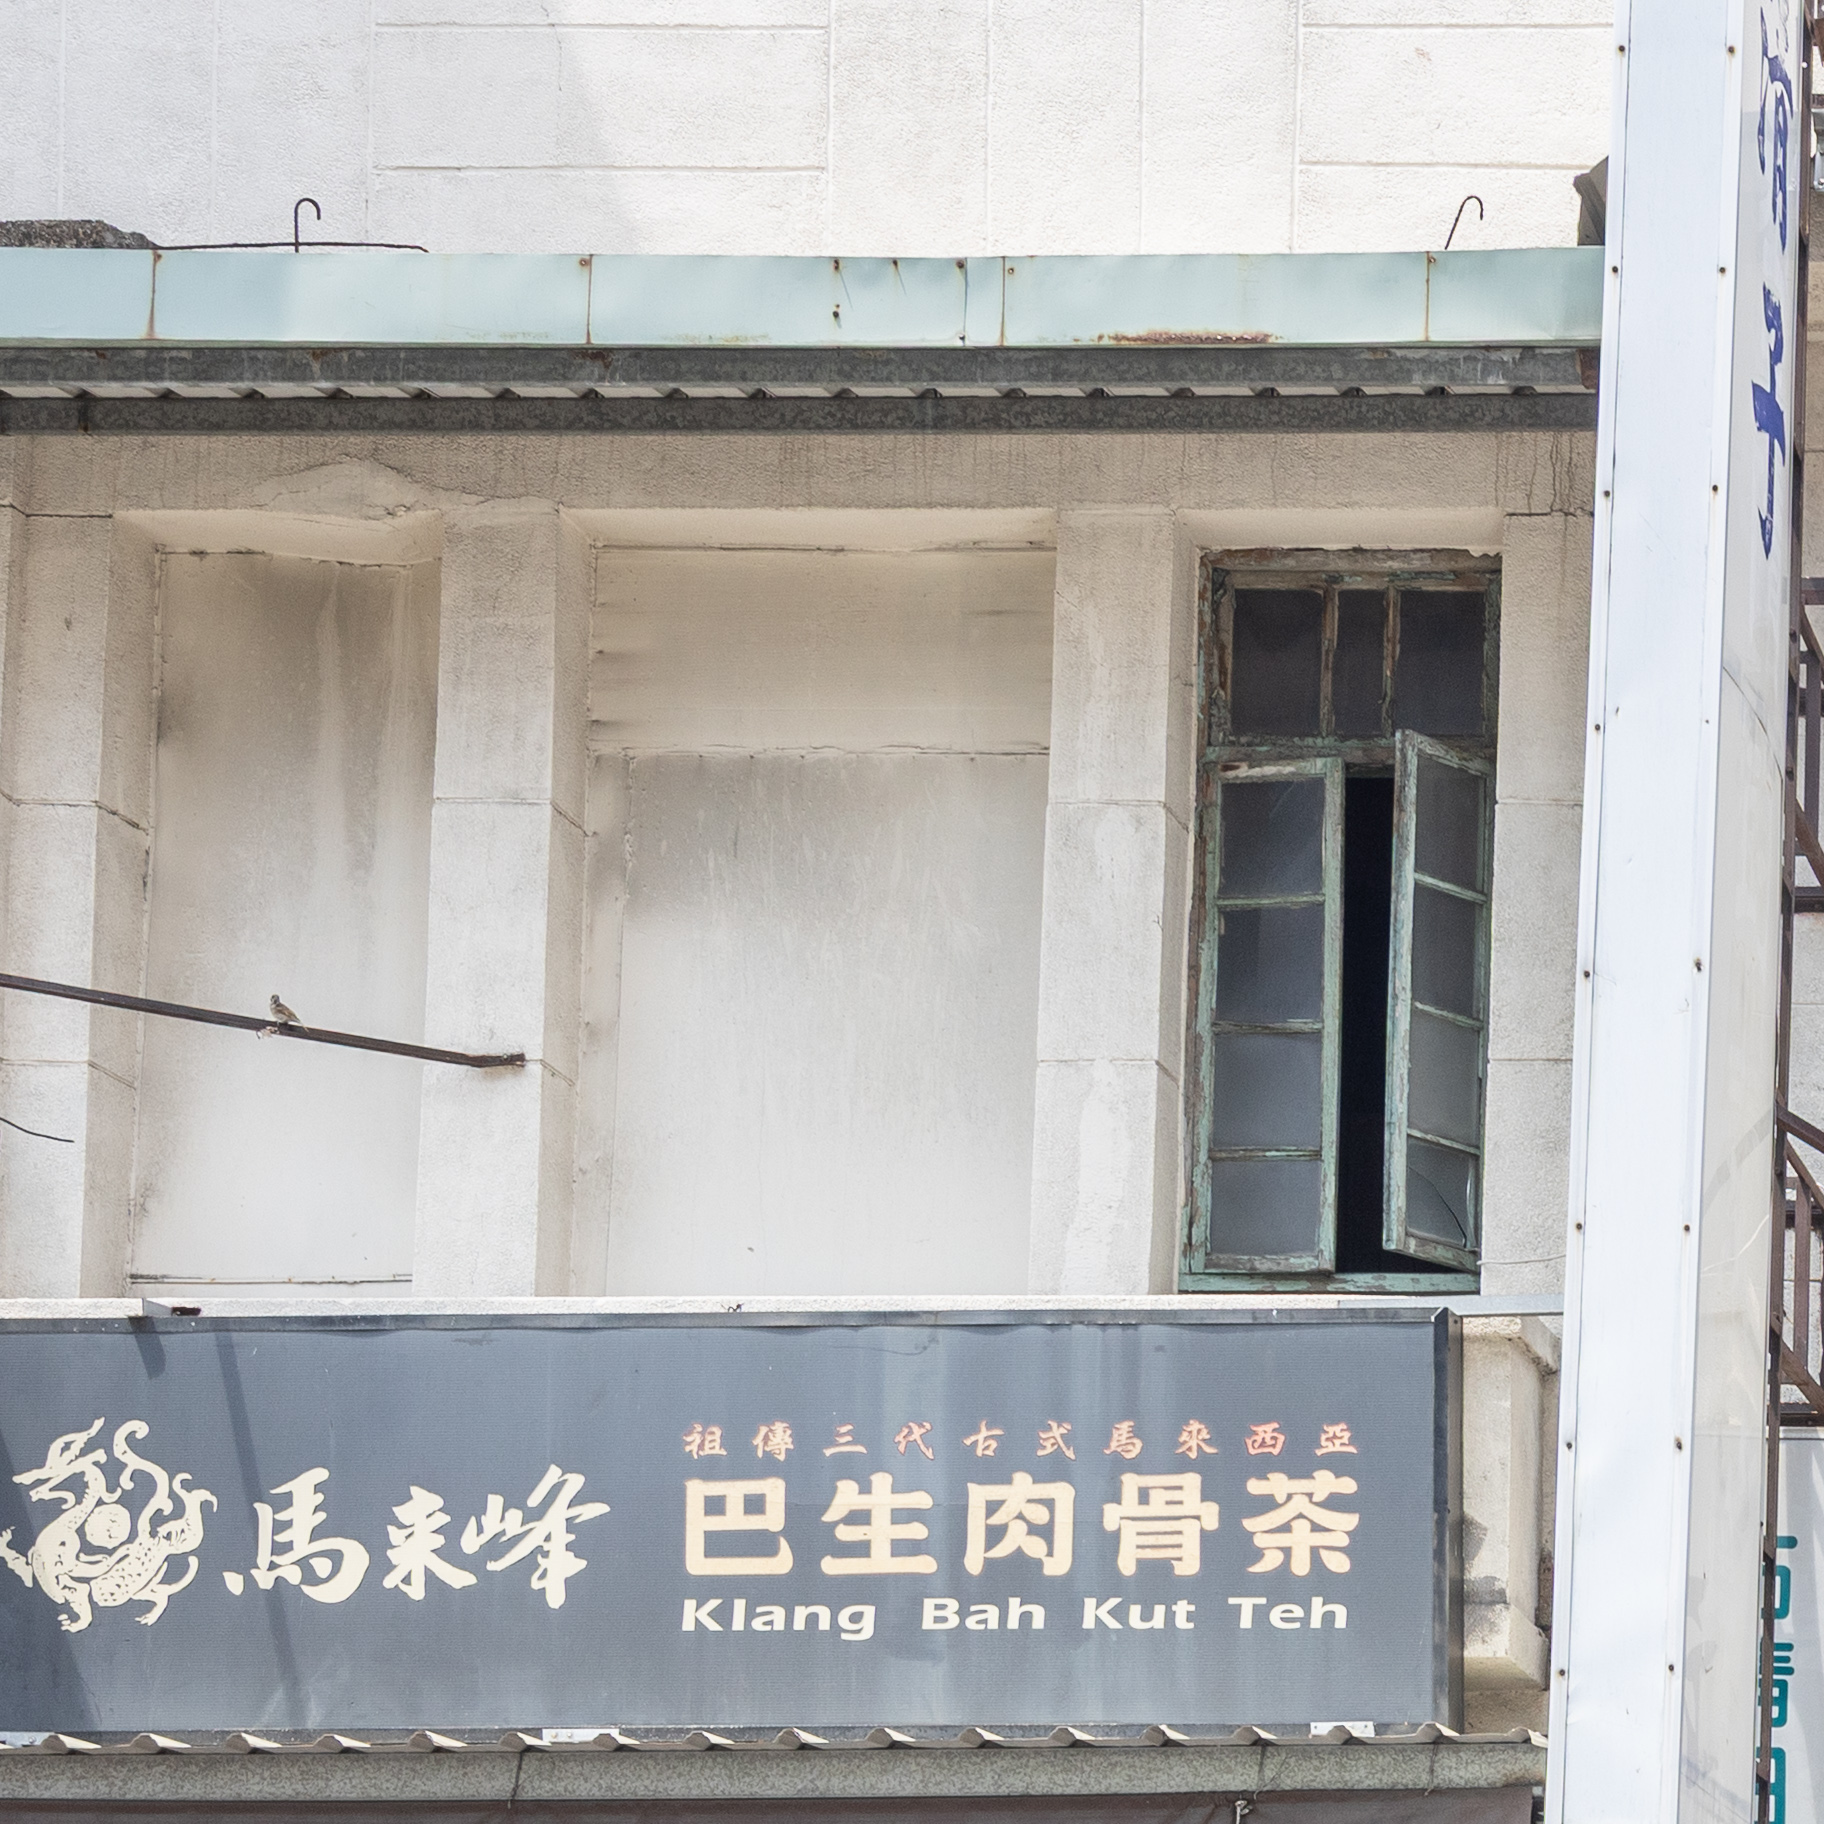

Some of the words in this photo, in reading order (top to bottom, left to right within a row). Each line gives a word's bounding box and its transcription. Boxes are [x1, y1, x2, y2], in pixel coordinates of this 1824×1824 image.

[683, 1472, 1362, 1577] 巴生肉骨茶
[683, 1597, 877, 1642] Klang
[922, 1595, 1046, 1631] Bah
[1081, 1595, 1196, 1630] Kut
[1228, 1595, 1351, 1630] Teh
